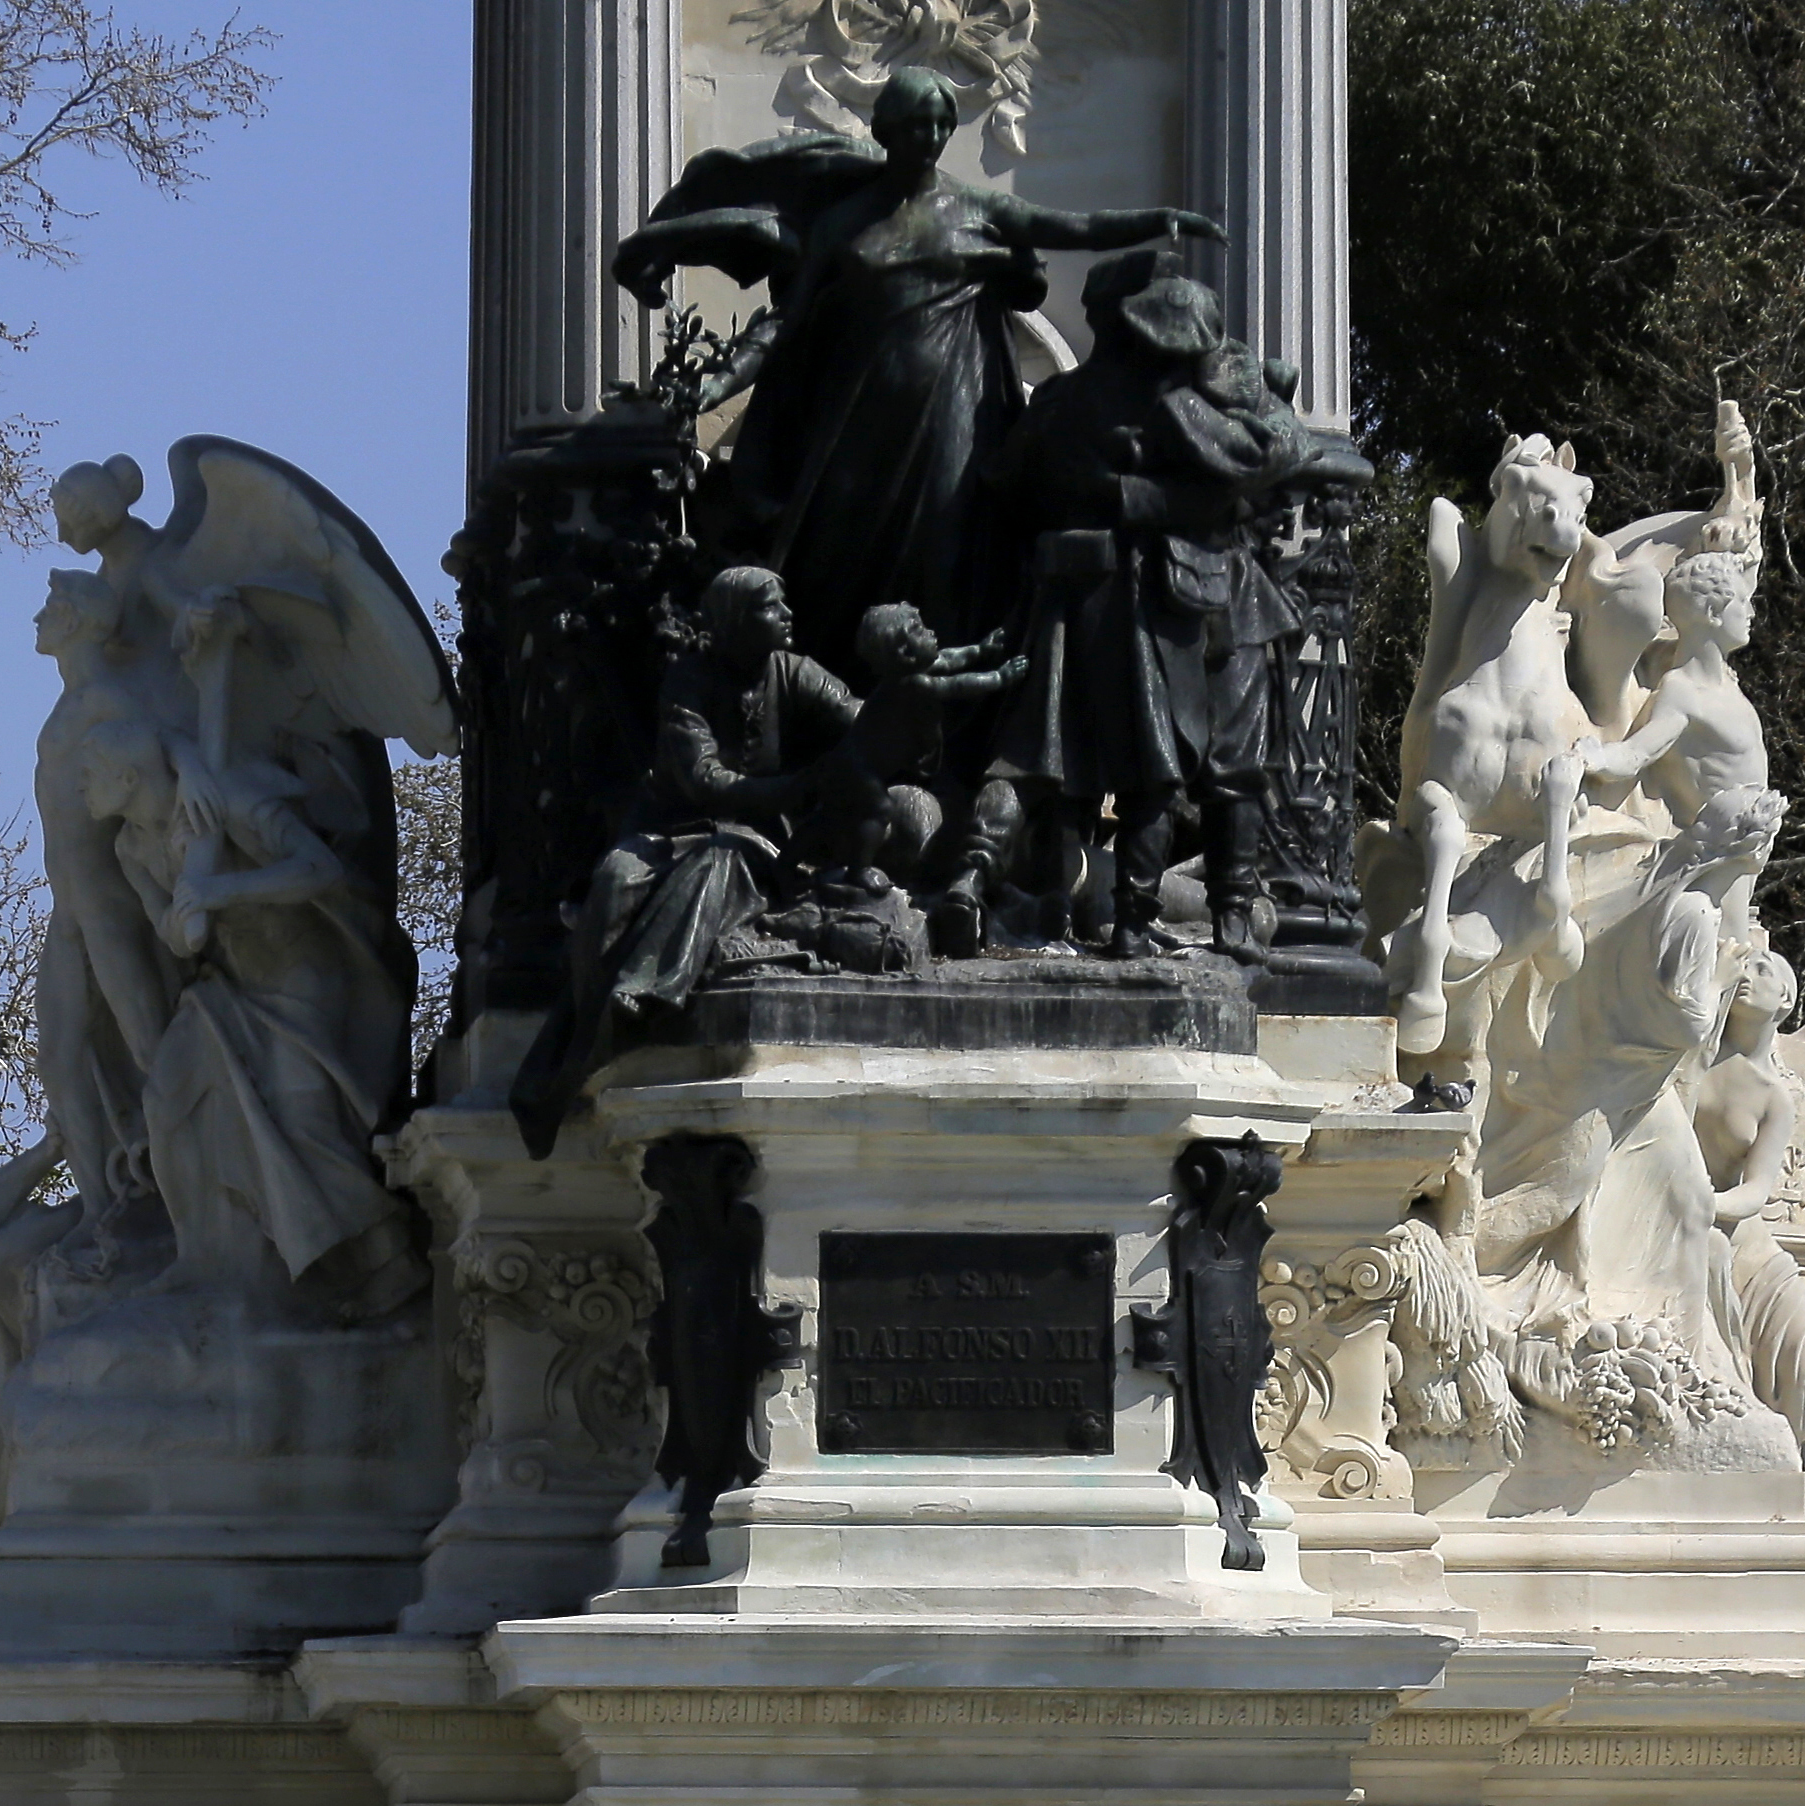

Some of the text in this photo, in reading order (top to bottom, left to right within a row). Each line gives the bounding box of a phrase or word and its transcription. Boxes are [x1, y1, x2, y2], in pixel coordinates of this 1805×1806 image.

[908, 1271, 942, 1299] A
[1045, 1326, 1099, 1364] XII
[847, 1378, 1085, 1409] EL PACIFICADOR
